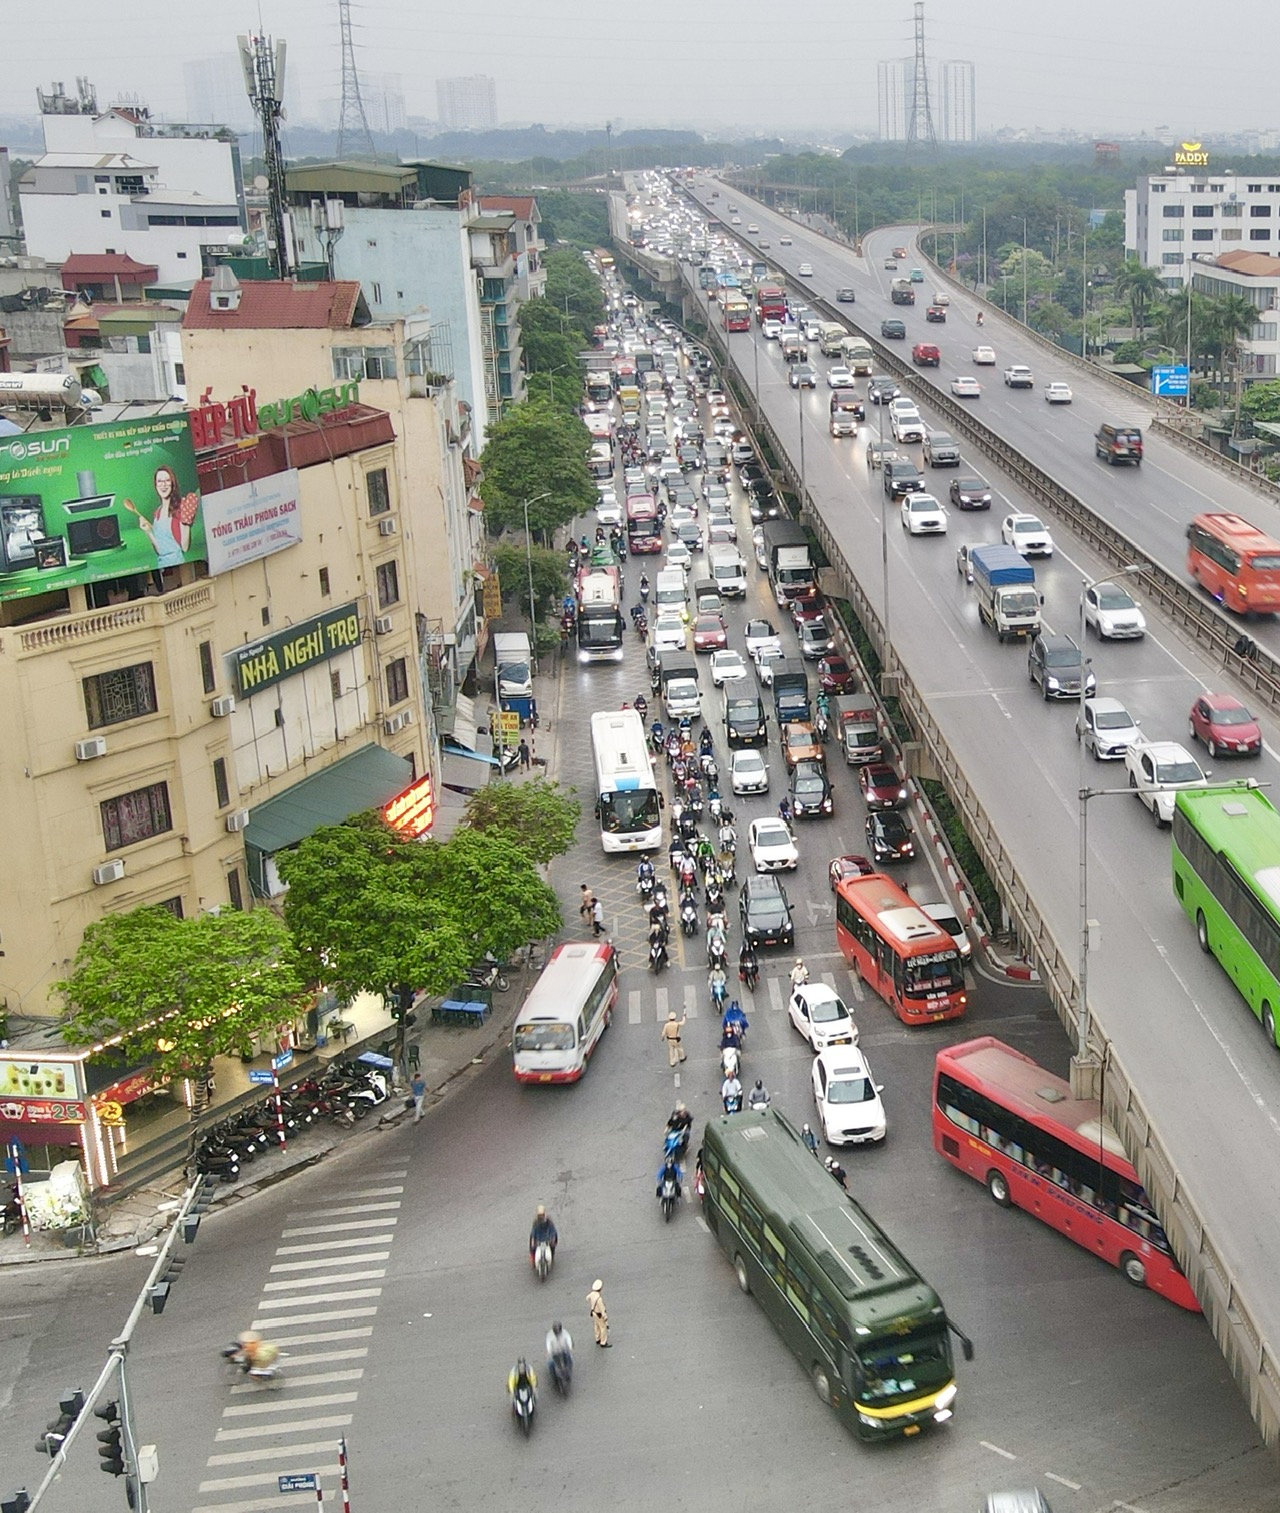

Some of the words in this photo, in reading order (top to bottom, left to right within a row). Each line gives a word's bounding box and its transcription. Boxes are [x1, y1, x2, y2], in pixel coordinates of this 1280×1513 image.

[1175, 152, 1209, 162] PADDY
[189, 386, 226, 449] BẾP
[211, 521, 233, 539] TỔNG
[233, 513, 253, 531] THẦU
[254, 507, 279, 524] PHÒNG
[279, 499, 297, 516] SẠCH
[241, 646, 280, 690] NHÀ
[283, 622, 325, 671] NGHỈ
[327, 615, 359, 649] TRỌ
